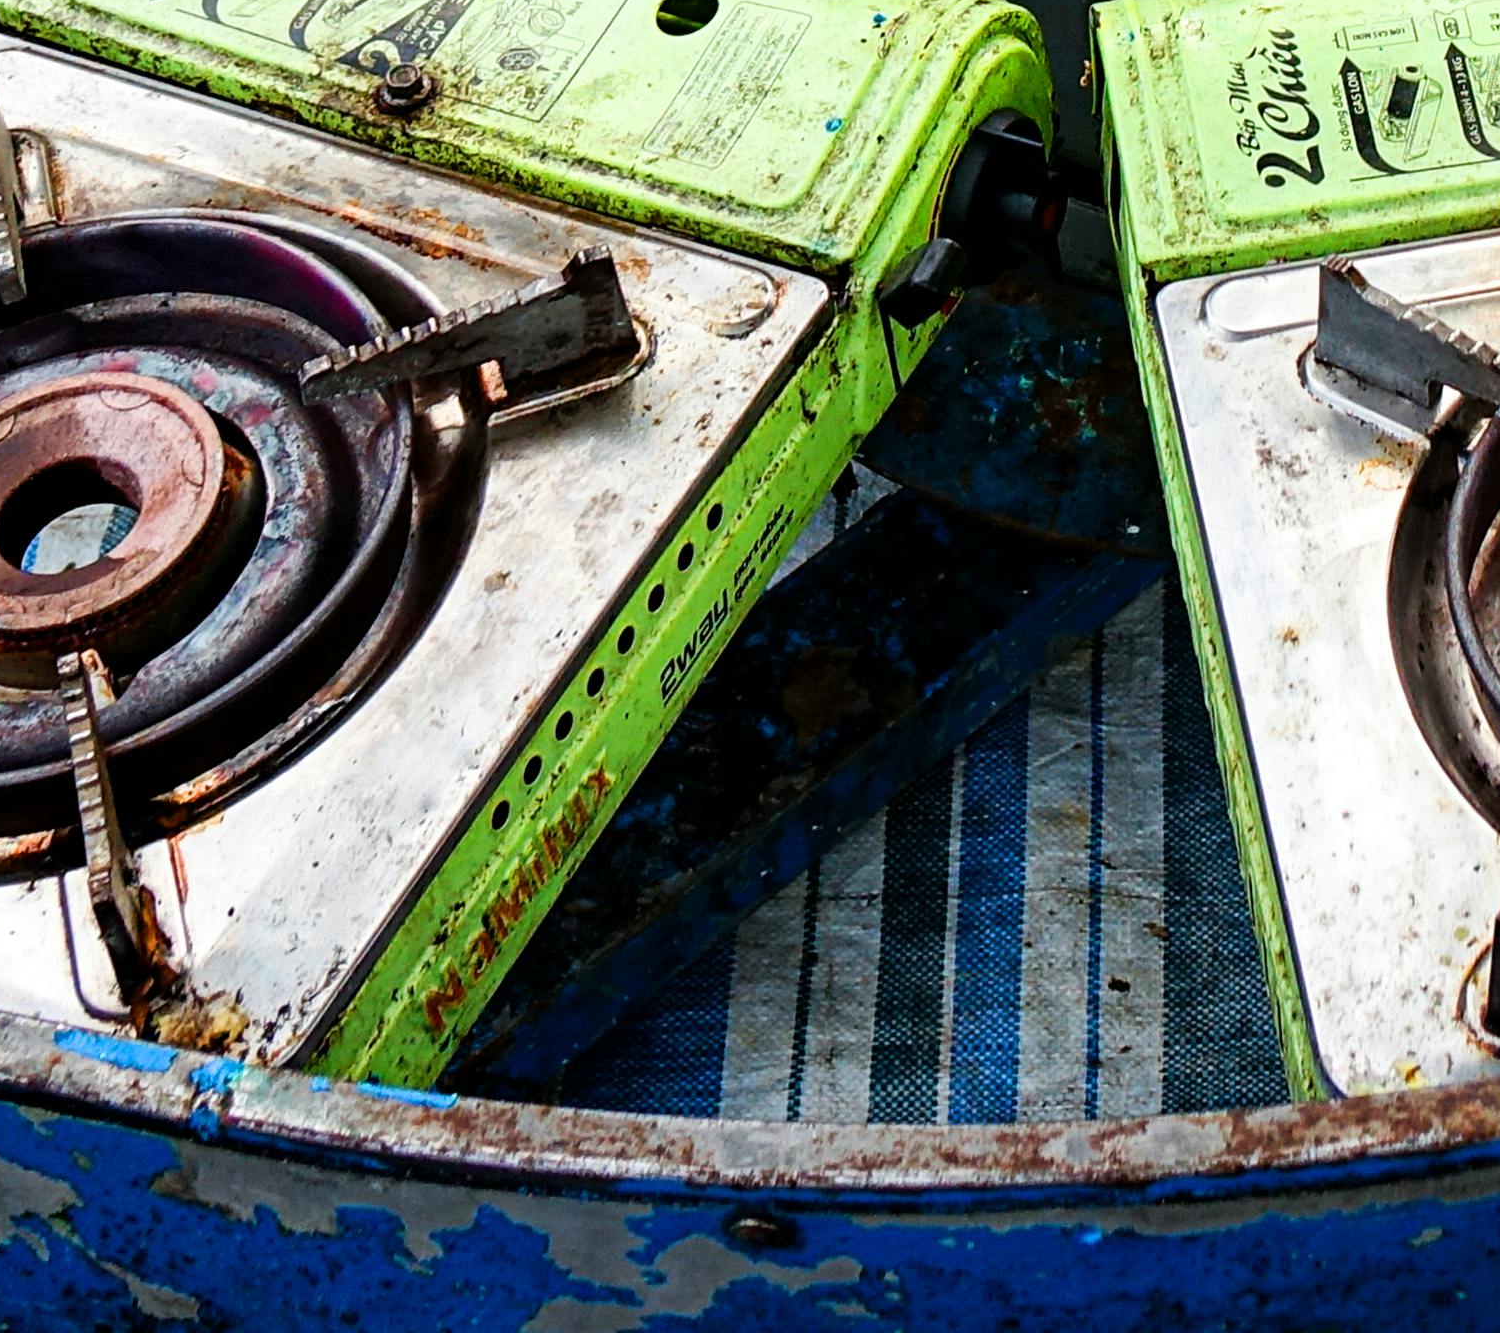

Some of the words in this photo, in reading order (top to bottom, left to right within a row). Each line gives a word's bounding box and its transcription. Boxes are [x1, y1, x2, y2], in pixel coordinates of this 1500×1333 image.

[1246, 25, 1320, 142] Chiều
[1346, 71, 1361, 93] LON
[1451, 56, 1464, 72] KG
[1227, 60, 1252, 114] Mini
[1351, 92, 1366, 115] GAS
[1236, 118, 1265, 158] Bếp
[1467, 123, 1482, 146] GAS
[1256, 144, 1326, 187] 2
[732, 501, 787, 585] portable
[659, 587, 733, 698] 2way
[424, 763, 614, 1035] NaMilux
